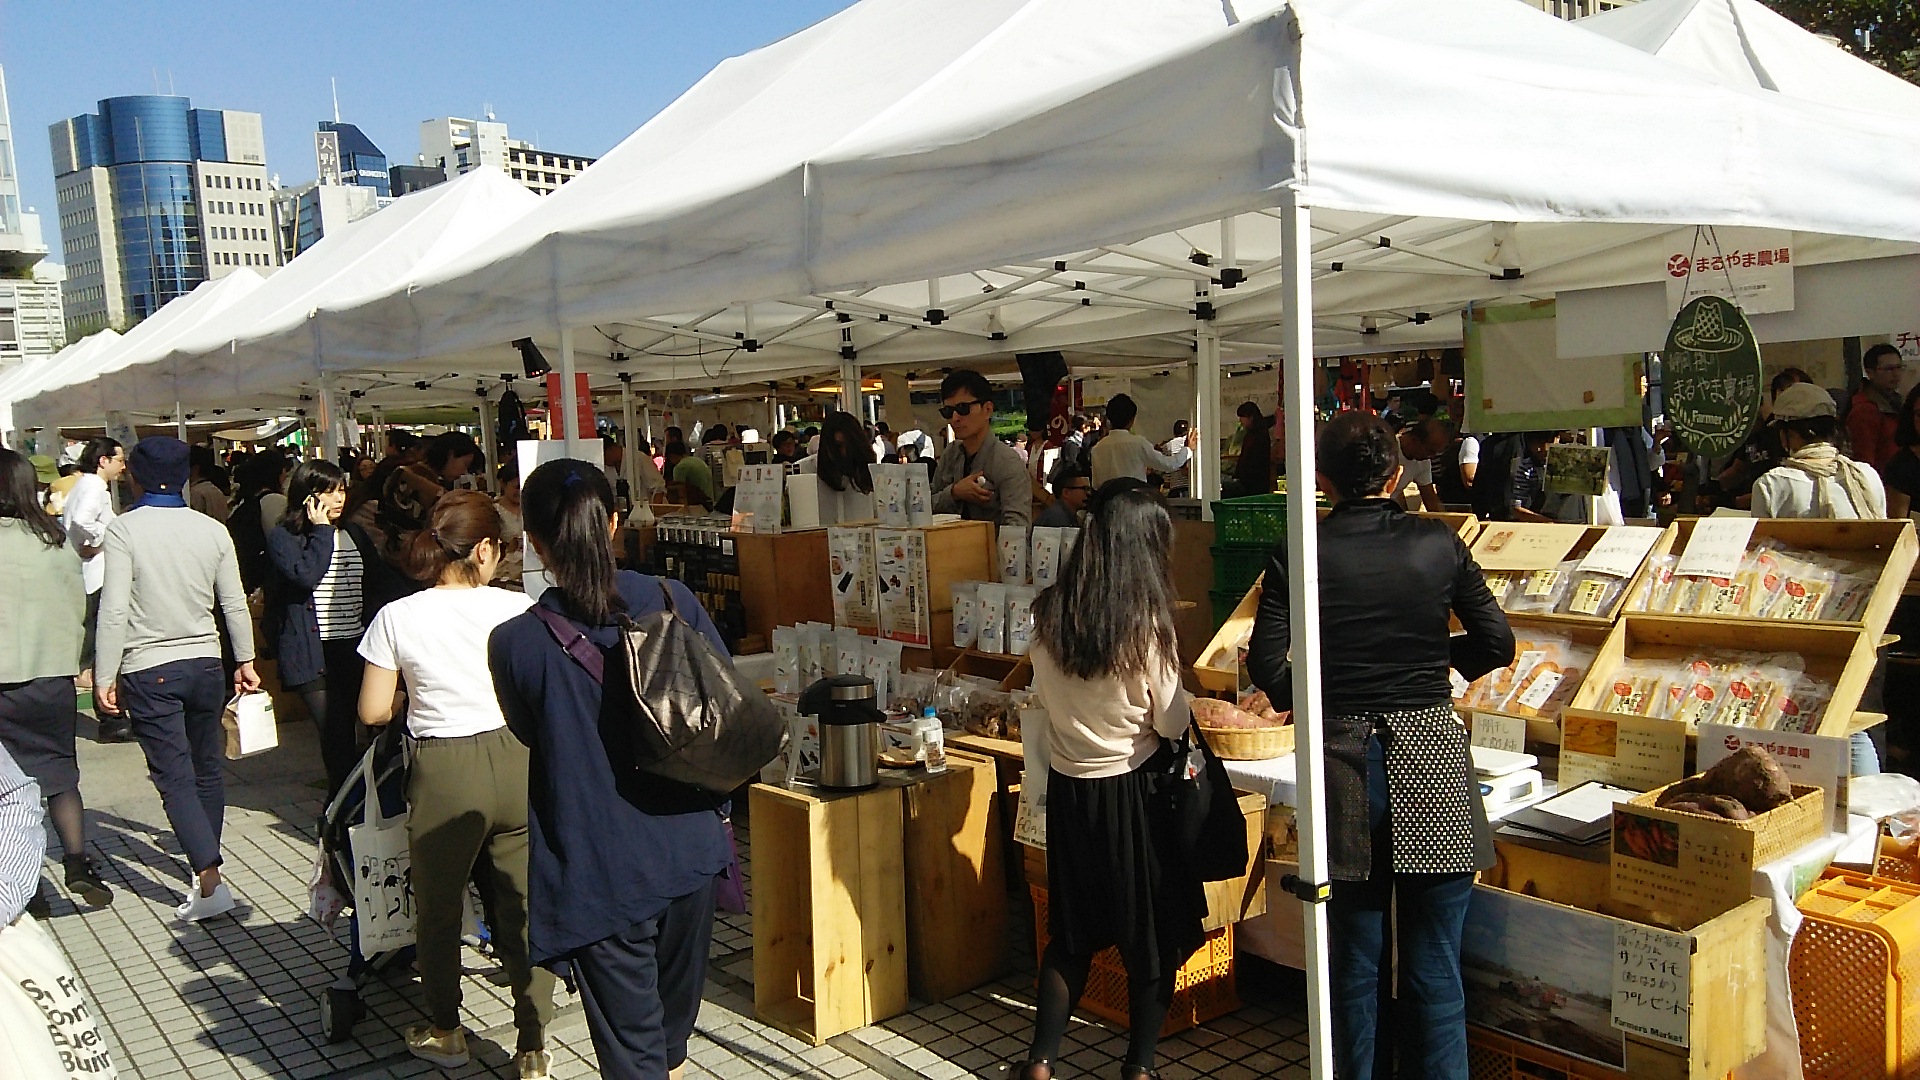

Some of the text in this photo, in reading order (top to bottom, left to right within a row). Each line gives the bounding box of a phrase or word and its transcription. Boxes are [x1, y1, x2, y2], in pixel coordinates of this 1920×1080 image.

[1696, 248, 1790, 273] まるやま農場
[1692, 409, 1724, 425] Farmer
[1618, 990, 1687, 1015] プレゼント
[1614, 1016, 1683, 1043] Farmers Market
